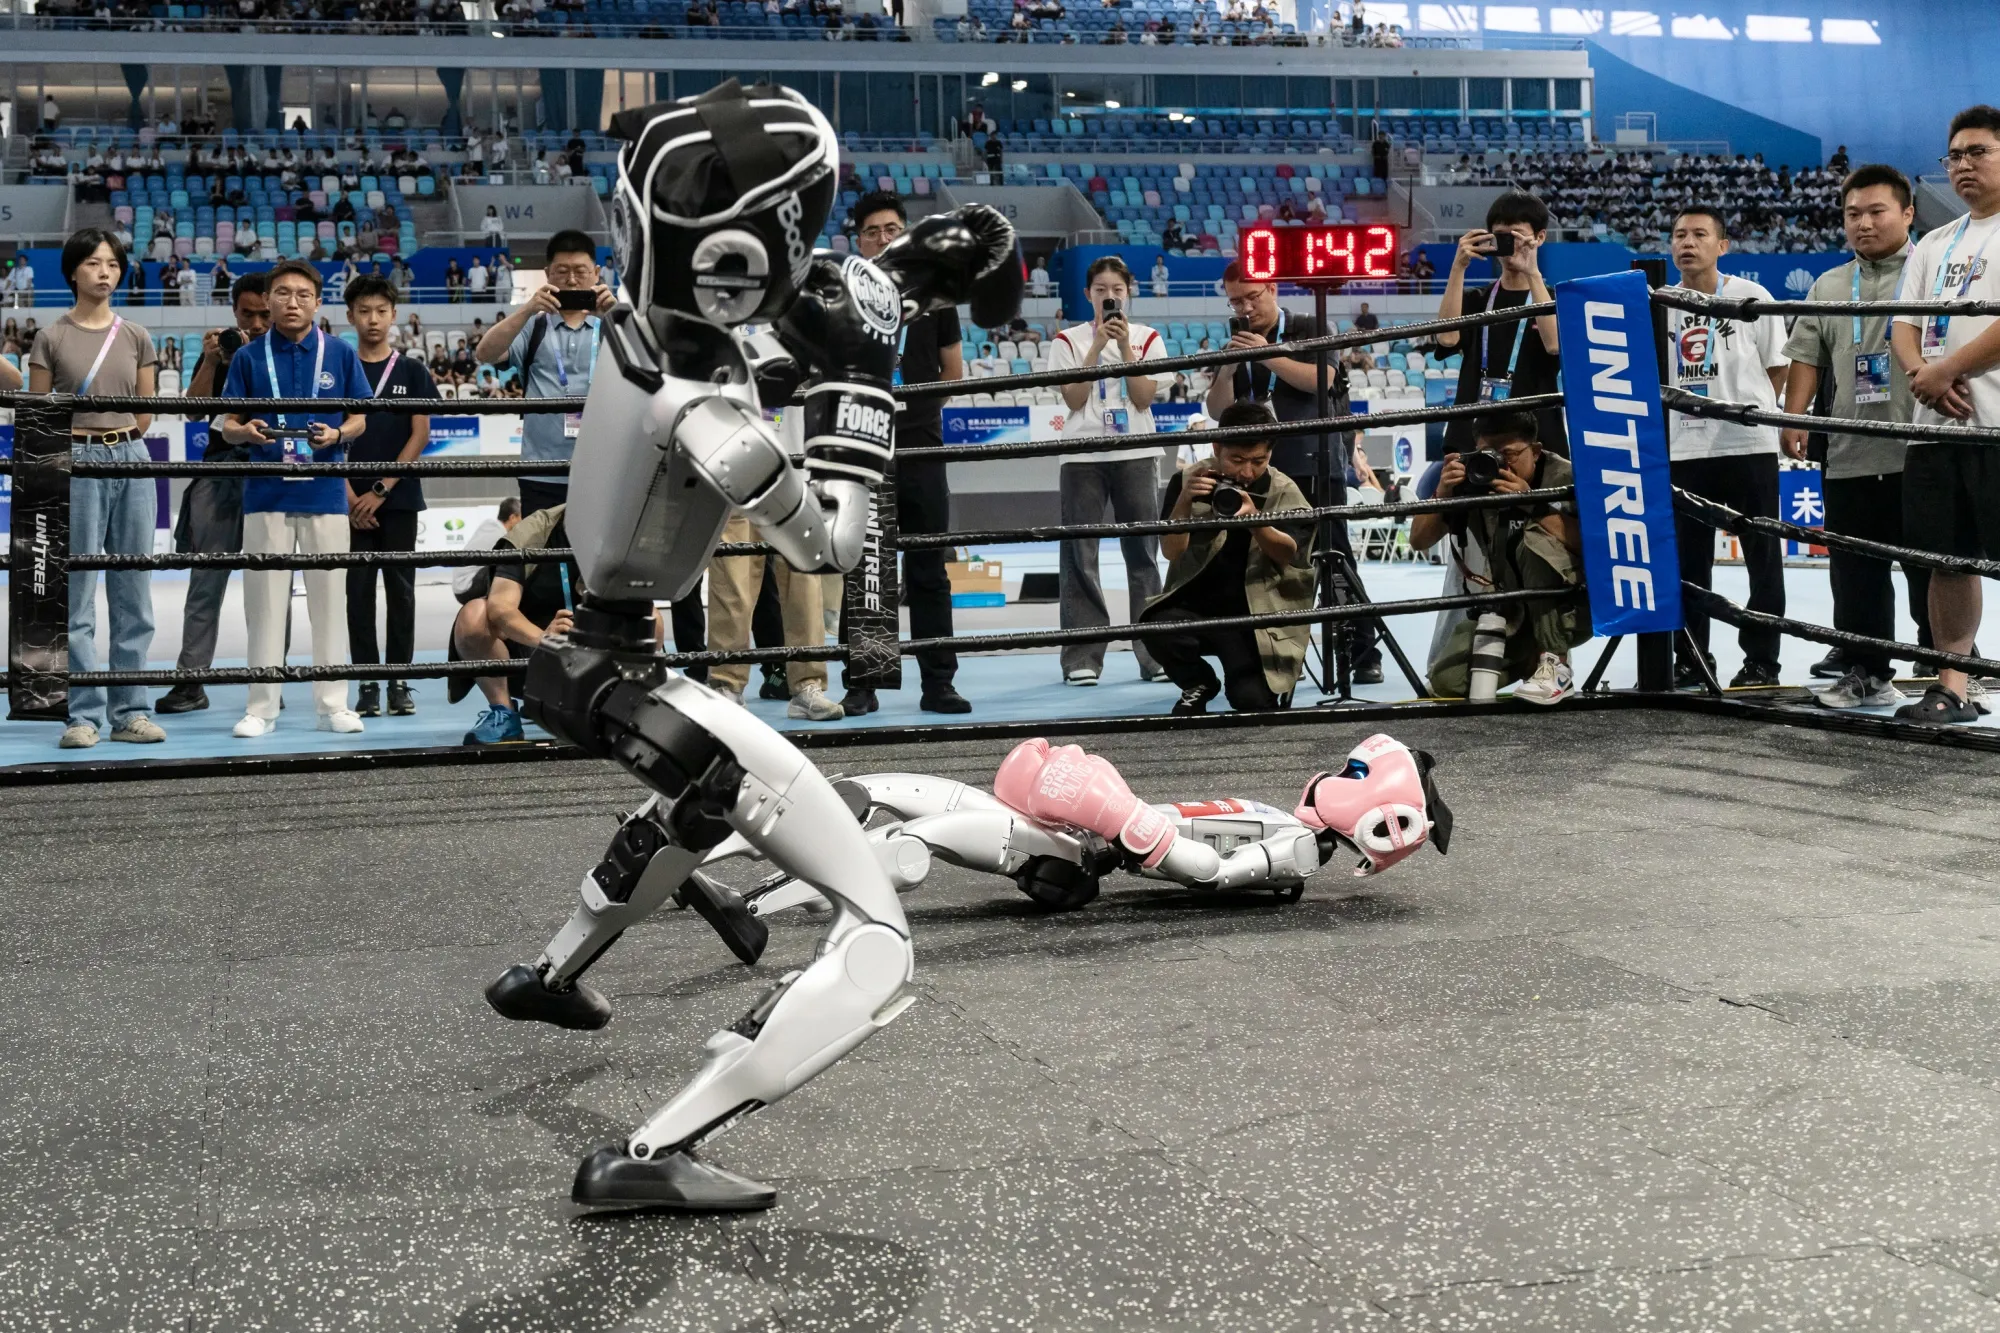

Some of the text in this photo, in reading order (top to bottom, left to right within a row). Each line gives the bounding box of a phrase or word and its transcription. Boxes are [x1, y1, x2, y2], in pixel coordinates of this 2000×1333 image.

[504, 204, 533, 219] W4
[1440, 203, 1464, 218] W2
[836, 402, 891, 440] FORCE
[1584, 301, 1656, 612] UNITREE
[1791, 486, 1823, 524] 未
[31, 513, 50, 596] UNITREE
[1056, 761, 1093, 805] YOUNG
